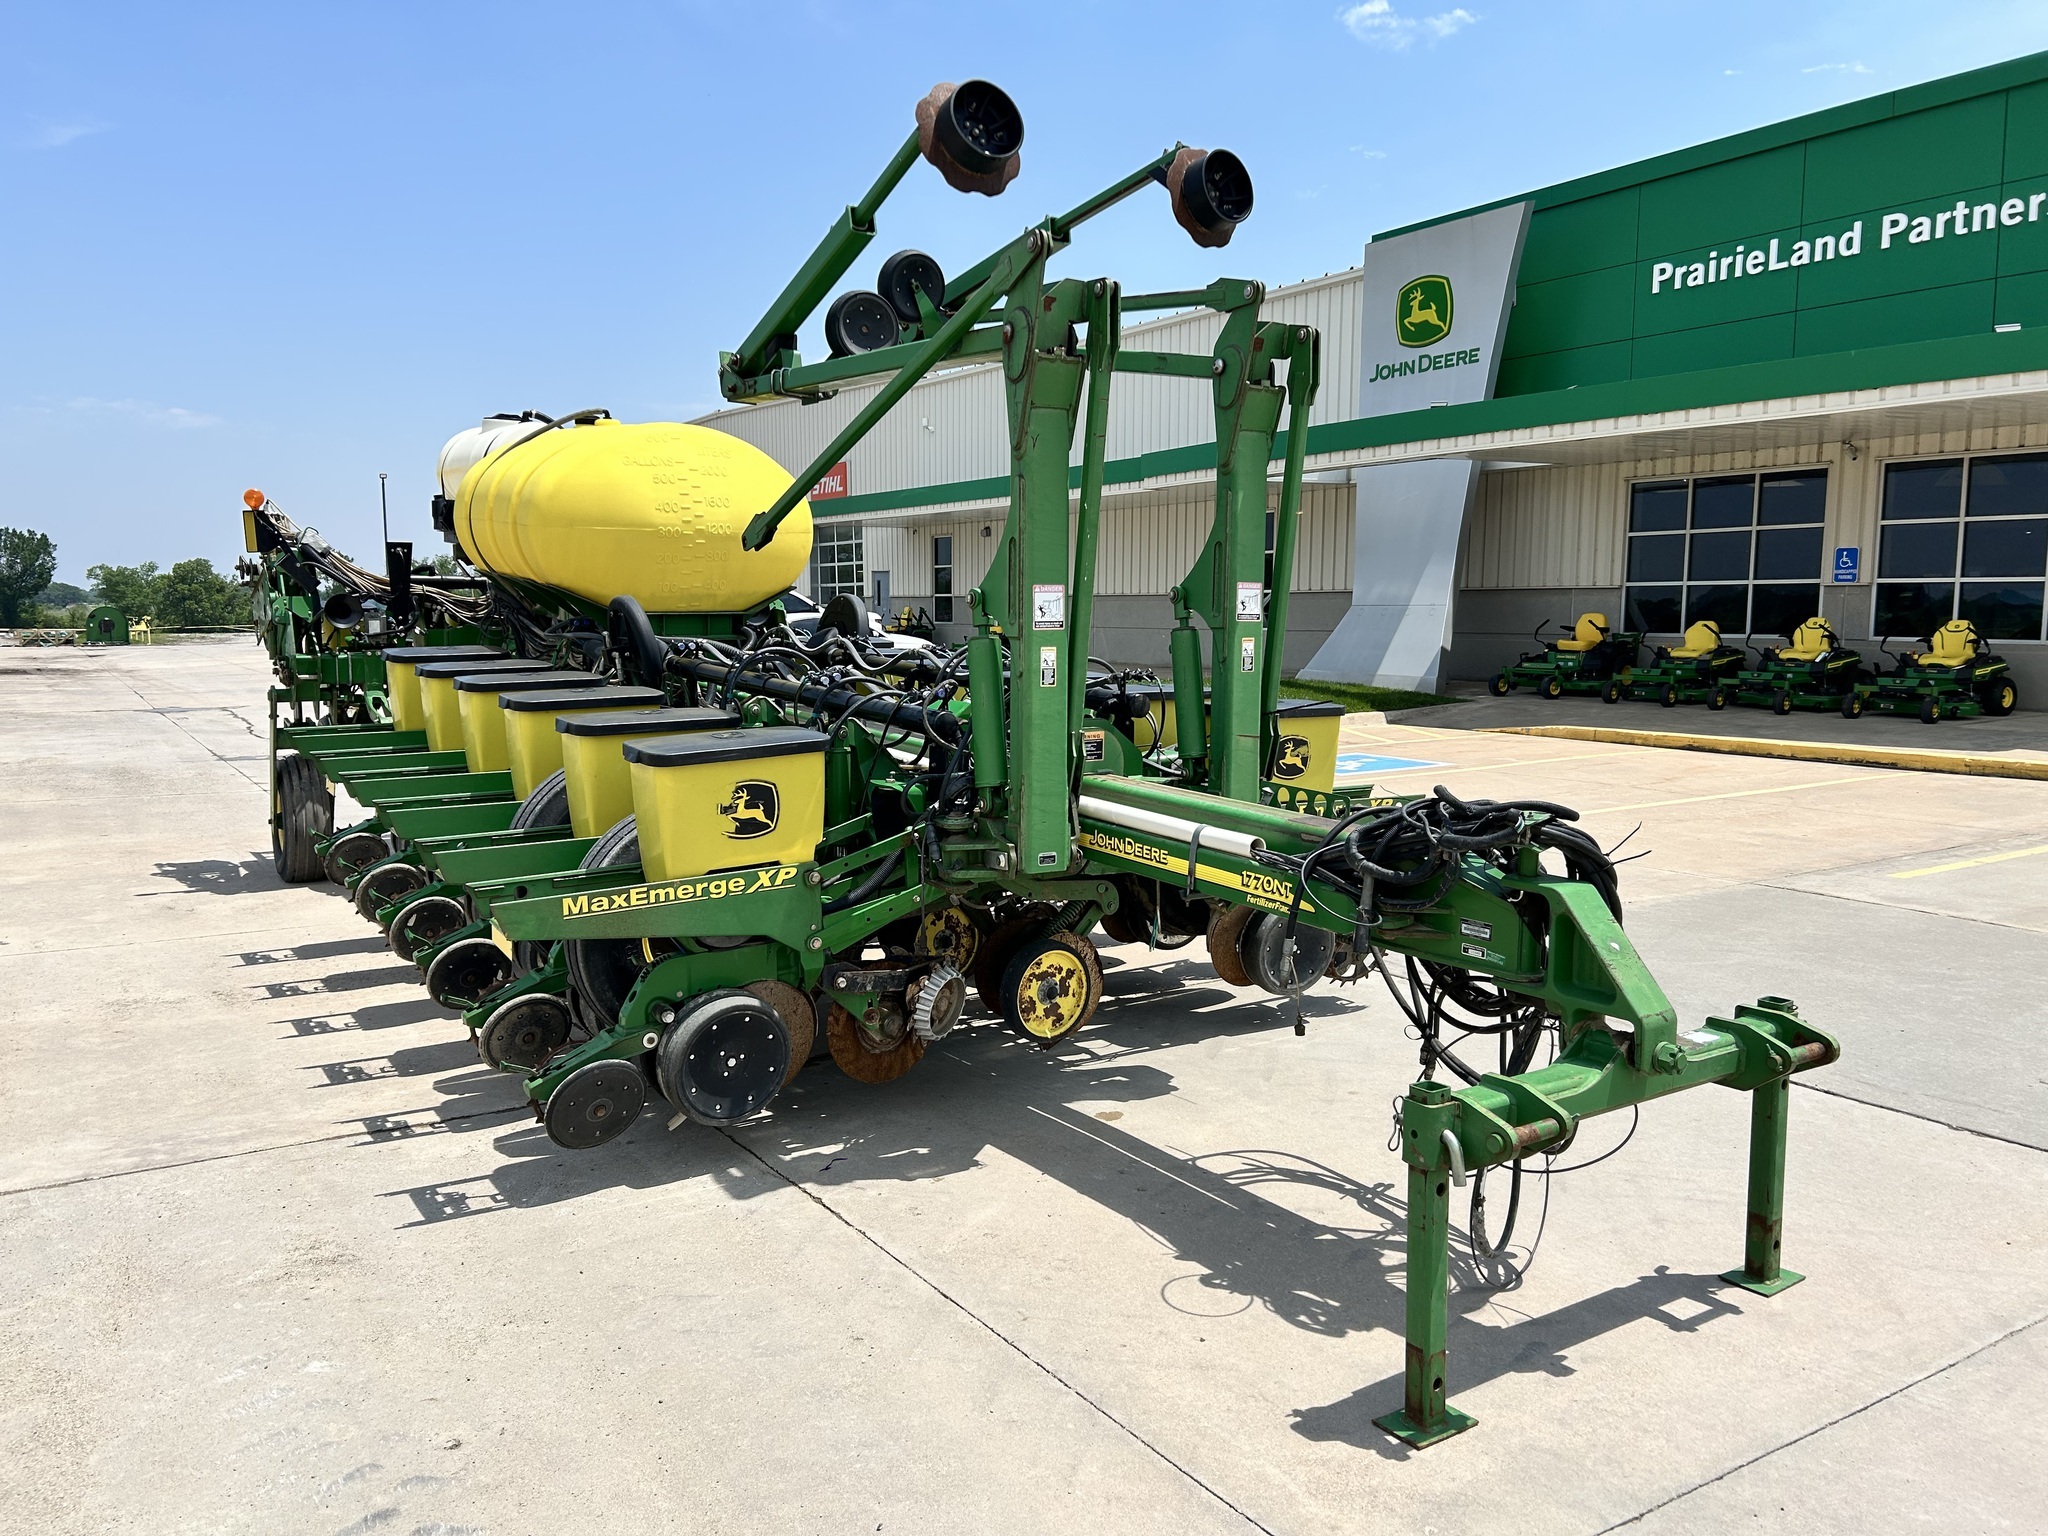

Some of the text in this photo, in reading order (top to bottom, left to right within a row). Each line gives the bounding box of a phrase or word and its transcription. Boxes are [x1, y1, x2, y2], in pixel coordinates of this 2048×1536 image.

[1651, 192, 2048, 294] PrairieLand Partner
[1369, 347, 1480, 383] JOHN DEERE
[622, 455, 674, 467] GALLONS
[700, 465, 728, 477] 2000
[652, 473, 676, 484] 500
[655, 501, 680, 513] 400
[704, 496, 731, 508] 1600
[657, 526, 682, 538] 300
[706, 522, 733, 535] 1200
[656, 552, 681, 564] 200
[706, 550, 729, 562] 800
[659, 581, 678, 593] 100
[704, 579, 727, 590] 400
[1090, 829, 1169, 865] JOHN DEERE
[1241, 870, 1293, 898] 1770NT
[562, 867, 798, 916] MaxEmerge XP
